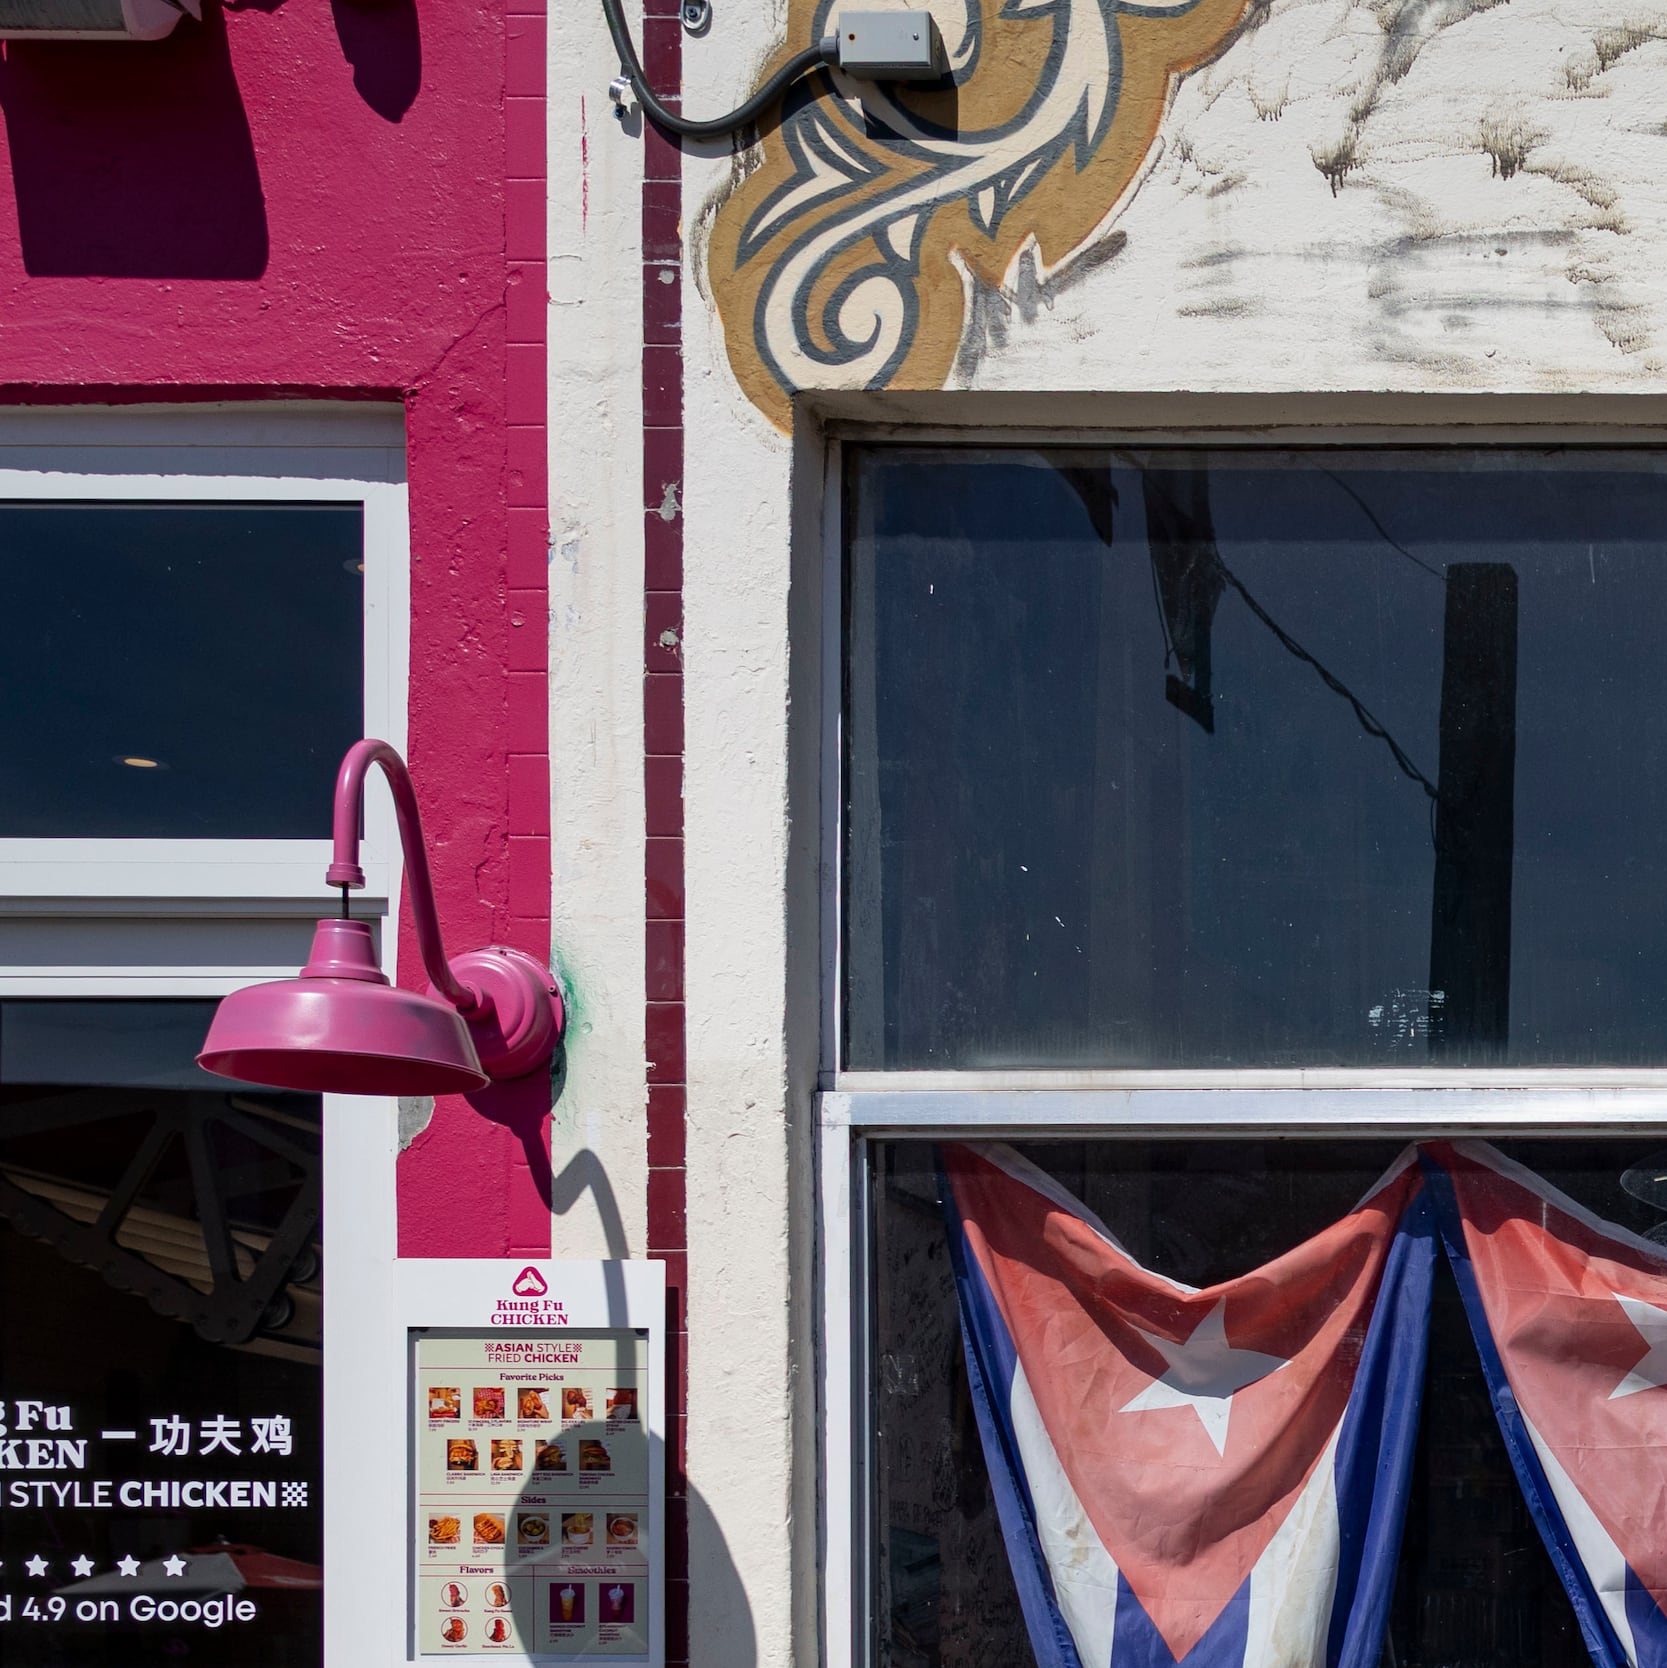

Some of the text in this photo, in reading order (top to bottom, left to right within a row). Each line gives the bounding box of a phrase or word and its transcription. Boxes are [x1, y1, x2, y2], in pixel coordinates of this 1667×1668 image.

[496, 1300, 563, 1313] Kung Fu
[490, 1314, 569, 1325] CHICKEN
[495, 1343, 574, 1353] ASIAN STYLE
[488, 1354, 578, 1363] FRIED CHICKEN
[500, 1373, 565, 1381] Favorite Picks
[15, 1400, 74, 1431] Fu
[10, 1481, 277, 1507] STYLE CHICKEN
[460, 1566, 494, 1574] Flavors
[22, 1596, 67, 1621] 4.9
[75, 1600, 120, 1621] on
[129, 1594, 257, 1628] Google
